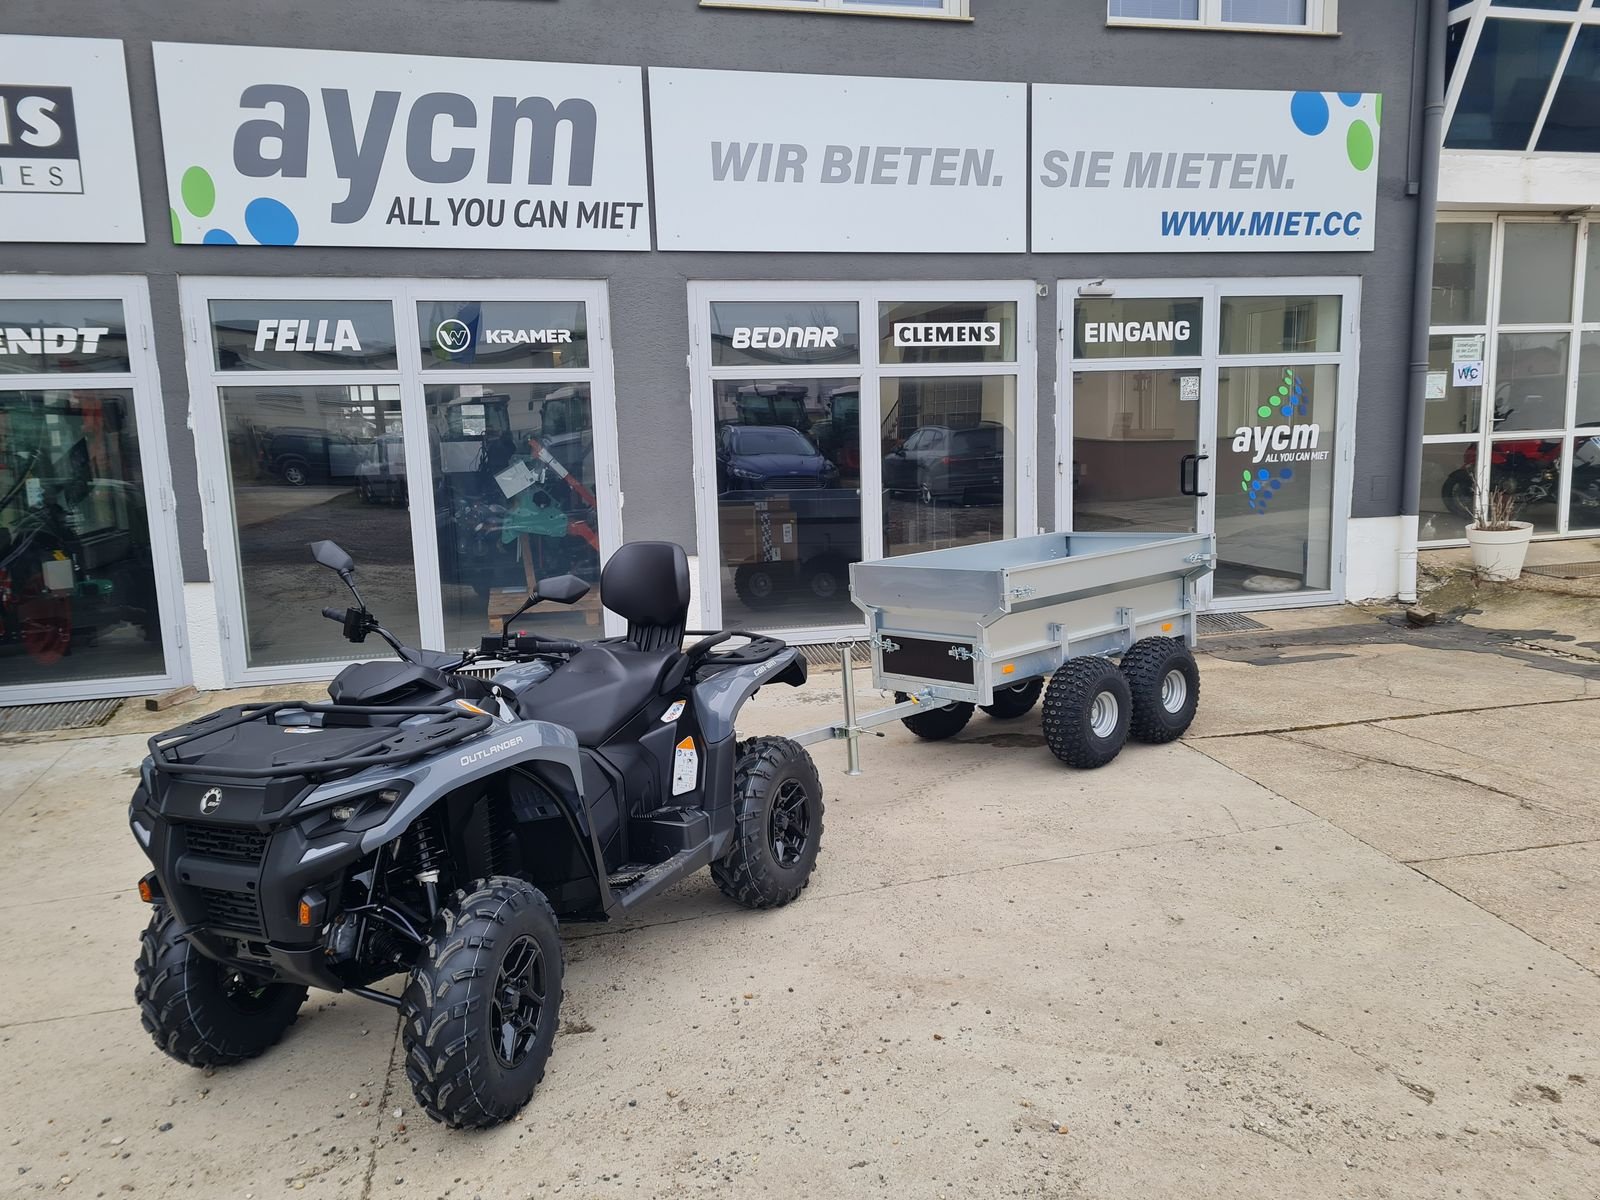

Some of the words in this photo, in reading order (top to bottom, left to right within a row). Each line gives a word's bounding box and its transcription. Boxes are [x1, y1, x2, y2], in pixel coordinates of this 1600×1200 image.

[0, 95, 62, 148] S
[232, 83, 598, 225] aycm
[710, 141, 808, 184] WIR
[820, 144, 1004, 187] BIETEN.
[1039, 149, 1115, 189] SIE
[1122, 151, 1296, 190] MIETEN.
[385, 196, 441, 226] ALL
[447, 197, 506, 228] YOU
[513, 199, 569, 229] CAN
[576, 201, 644, 230] MIET
[1160, 210, 1363, 237] WWW.MIET.CC
[254, 319, 362, 352] FELLA
[485, 329, 573, 344] KRAMER
[731, 326, 839, 349] BEDNAR
[898, 325, 996, 343] CLEMENS
[1084, 320, 1191, 344] EINGANG
[1457, 368, 1479, 380] WC
[1231, 423, 1320, 464] aycm
[1264, 453, 1280, 463] ALL
[1280, 452, 1296, 462] YOU
[1295, 451, 1311, 461] CAN
[1310, 450, 1330, 461] MIET
[460, 735, 525, 767] OUTLANDER
